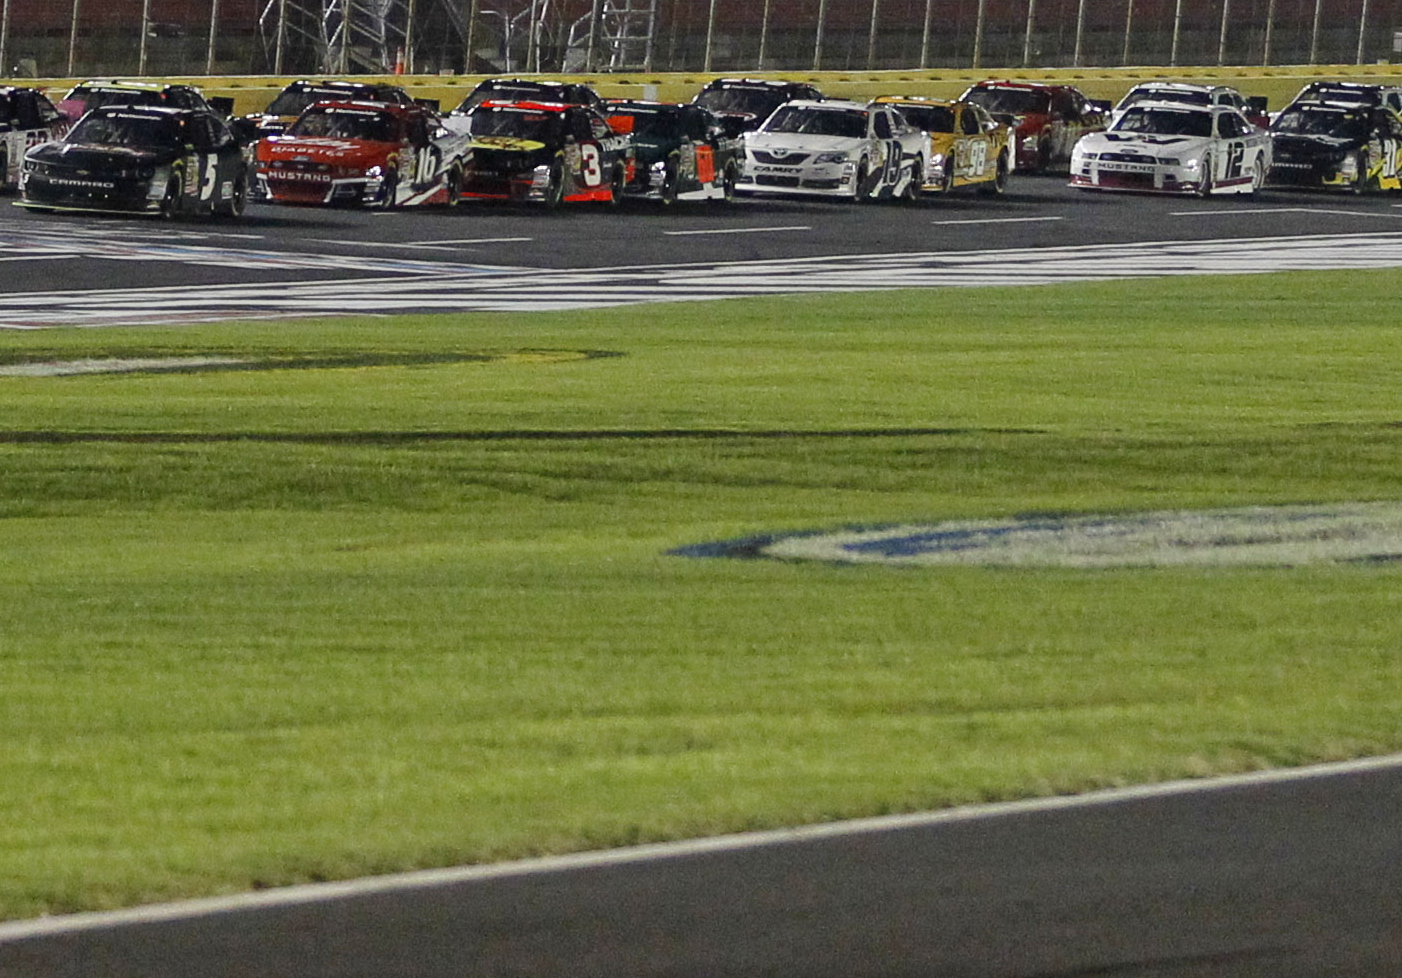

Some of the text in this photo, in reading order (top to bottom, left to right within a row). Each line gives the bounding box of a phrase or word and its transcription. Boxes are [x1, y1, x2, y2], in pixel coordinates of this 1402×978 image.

[271, 145, 345, 157] DIABETES
[414, 145, 437, 184] 16
[581, 143, 600, 187] 3
[1225, 141, 1245, 178] 12
[753, 165, 804, 173] CAMRY
[1097, 162, 1155, 173] MUSTANG
[200, 153, 218, 201] 5
[268, 171, 332, 182] MUSTANG
[49, 178, 115, 188] CAMARO
